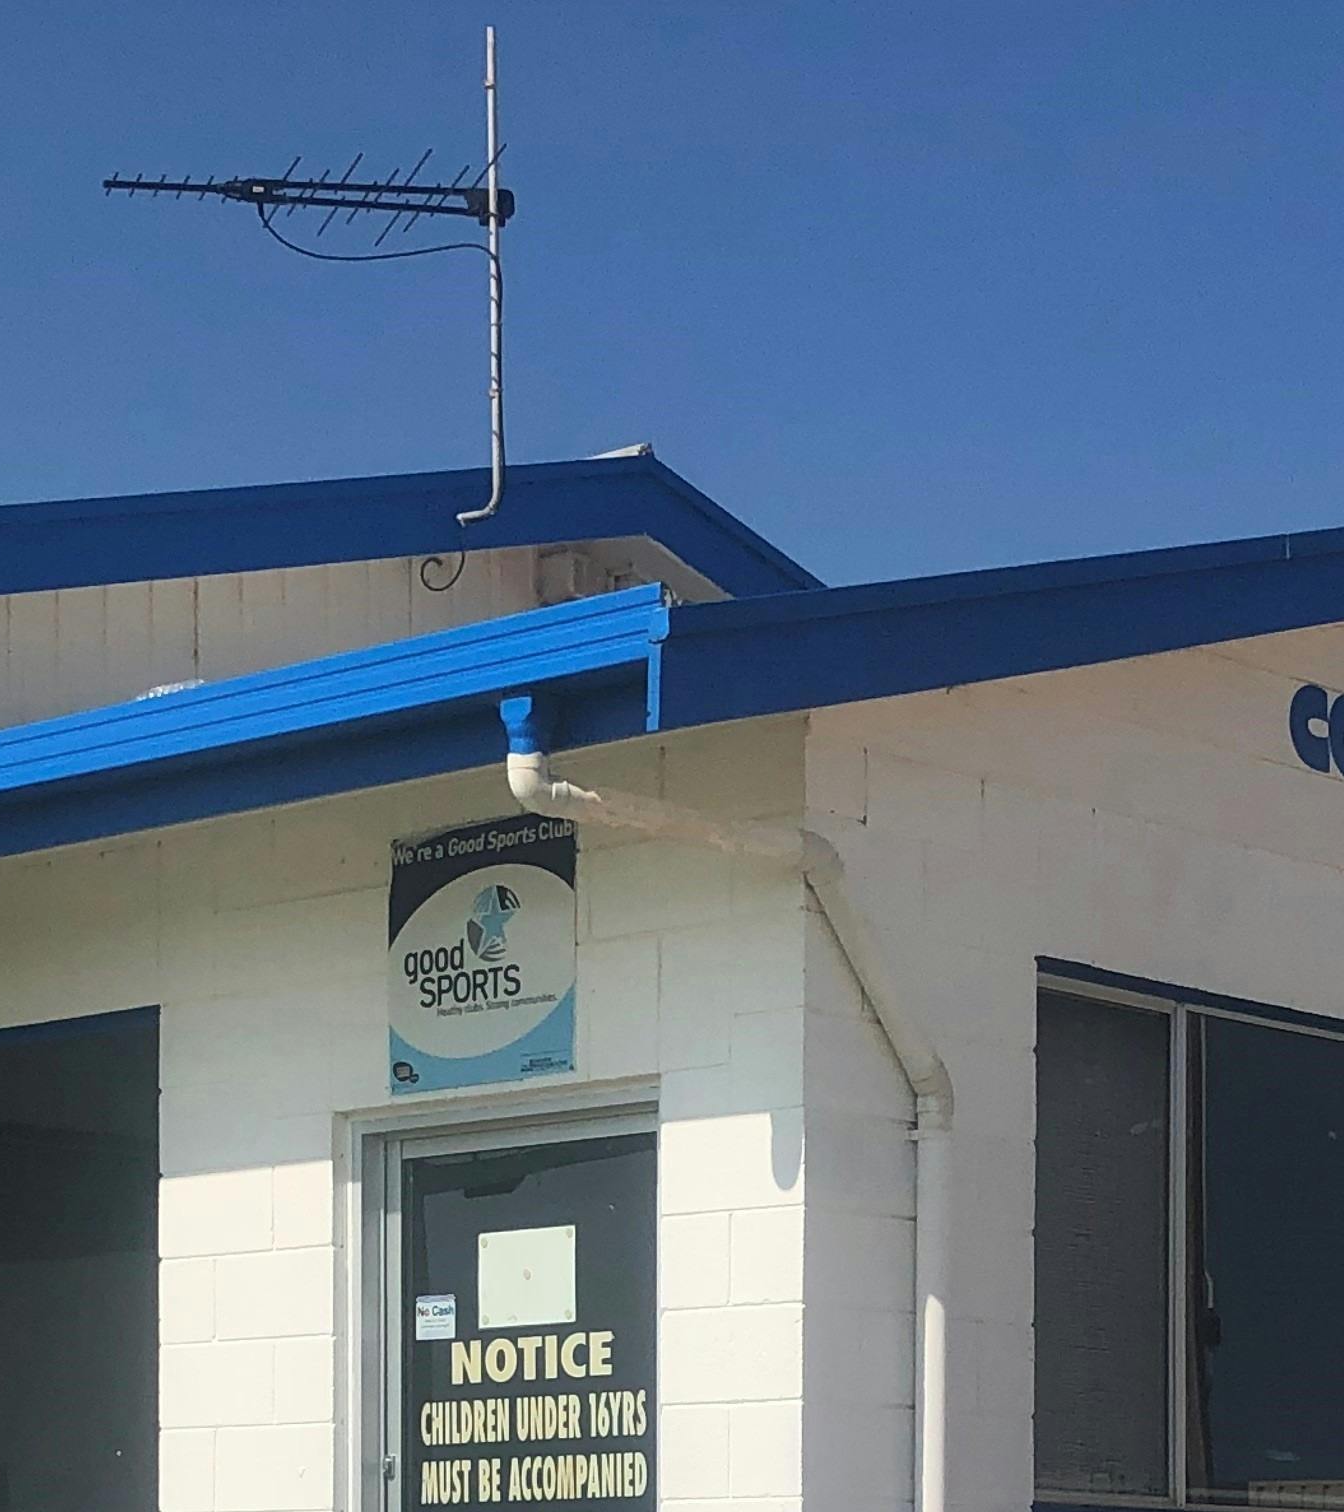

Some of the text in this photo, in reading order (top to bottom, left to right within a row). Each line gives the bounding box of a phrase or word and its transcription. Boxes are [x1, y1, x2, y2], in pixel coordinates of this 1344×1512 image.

[435, 843, 444, 859] a
[448, 832, 486, 857] Good
[487, 827, 536, 853] Sports
[404, 938, 464, 985] good
[419, 963, 521, 1009] SPORTS
[451, 1331, 614, 1385] NOTICE
[420, 1389, 647, 1446] CHILDREN UNDER 16YRS
[420, 1452, 648, 1505] MUST BE ACCOMPANIED
